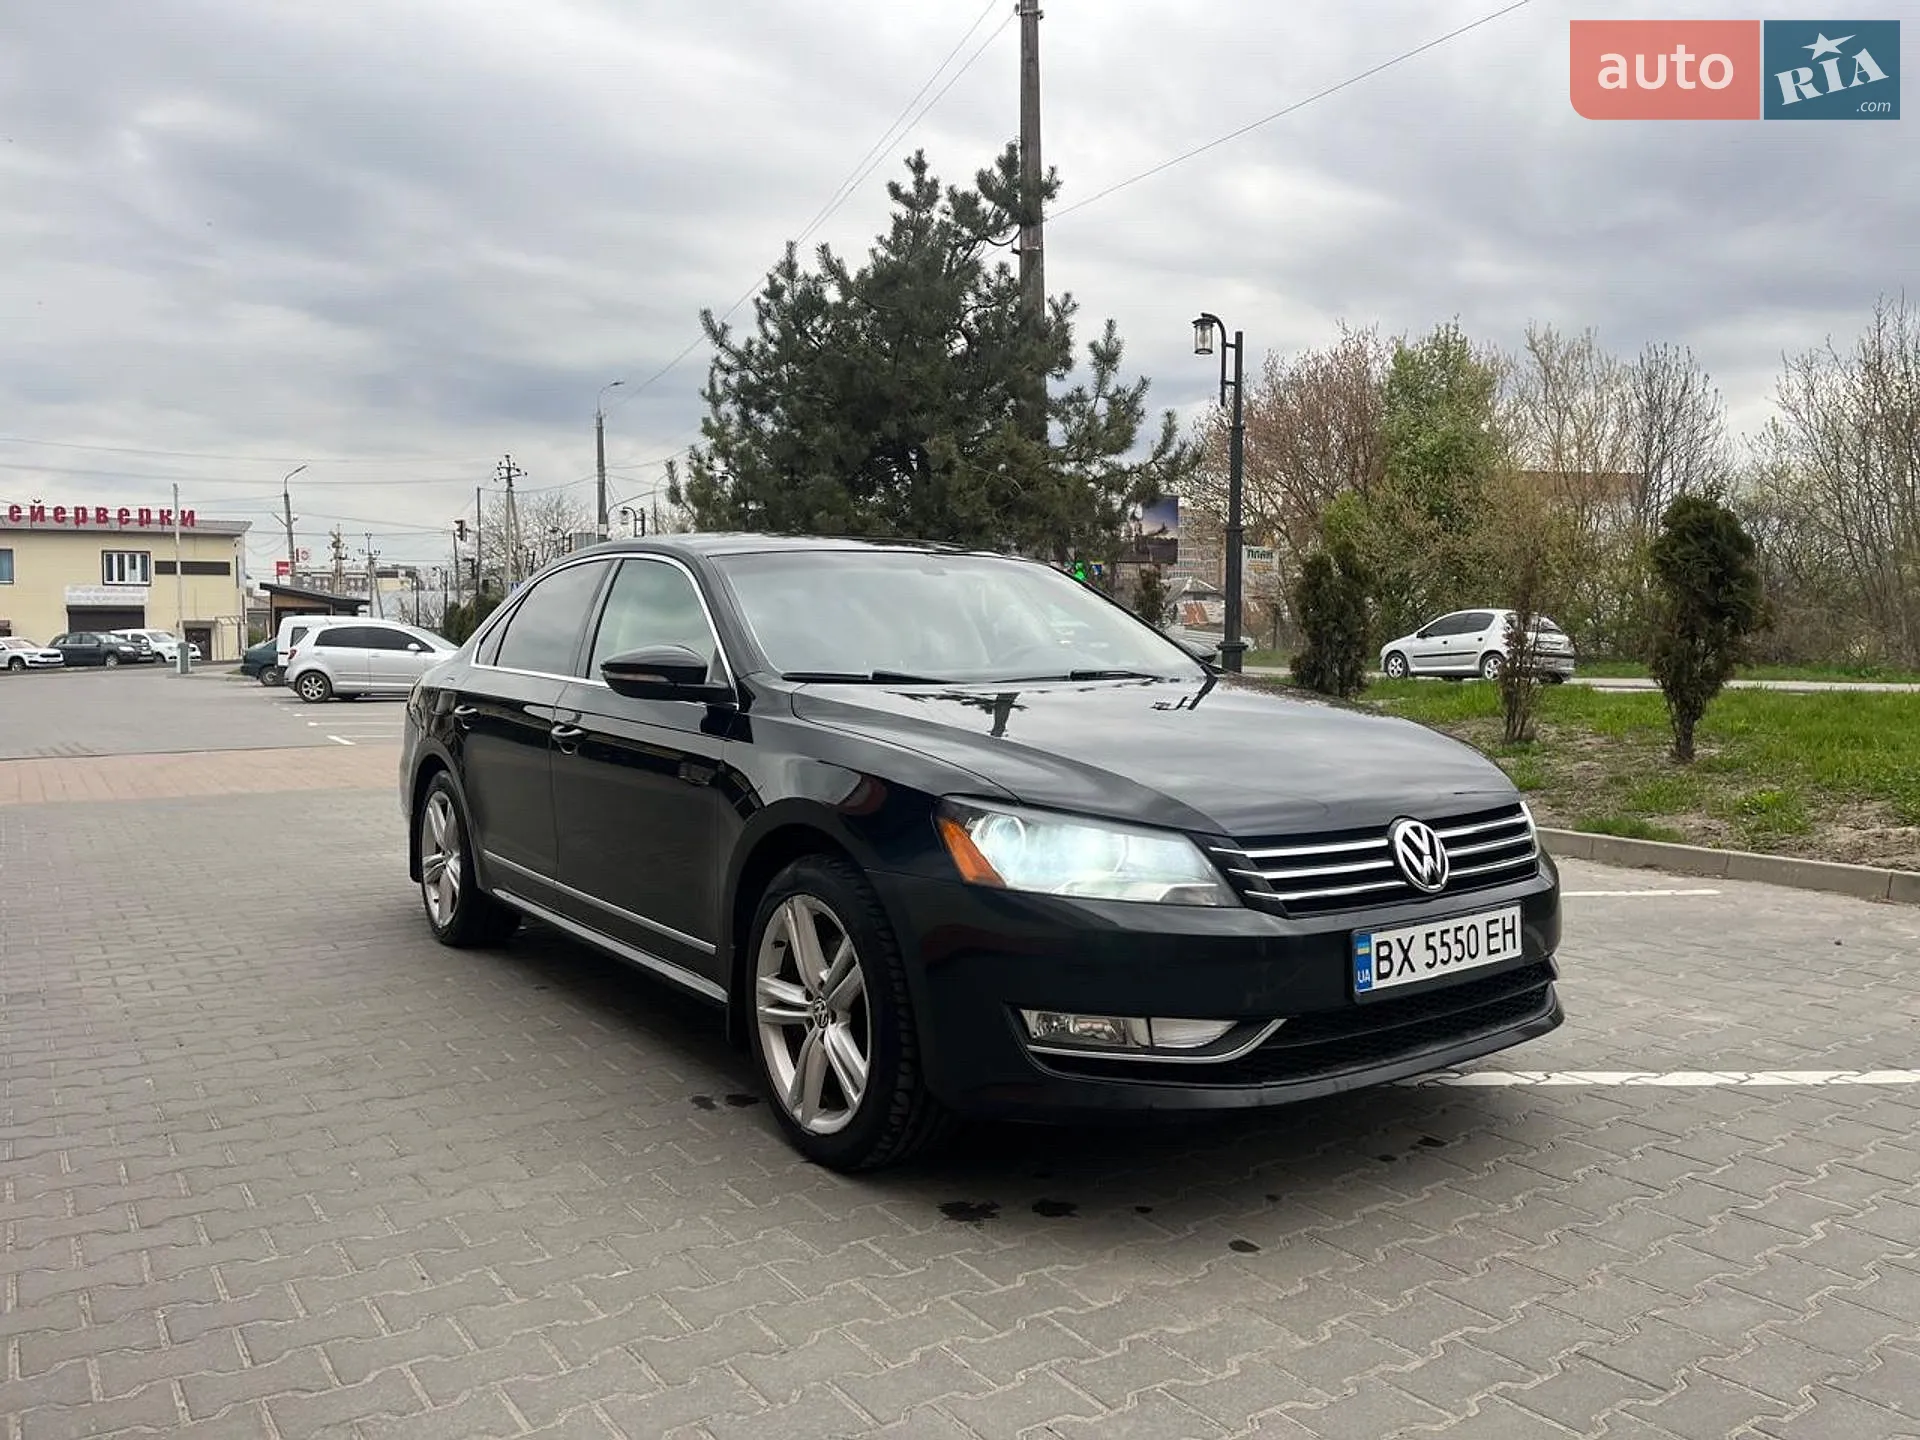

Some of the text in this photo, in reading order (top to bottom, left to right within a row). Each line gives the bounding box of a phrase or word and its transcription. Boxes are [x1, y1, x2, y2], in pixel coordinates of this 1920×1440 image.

[1375, 915, 1517, 981] BX 5550 EH
[1357, 969, 1371, 984] UA
